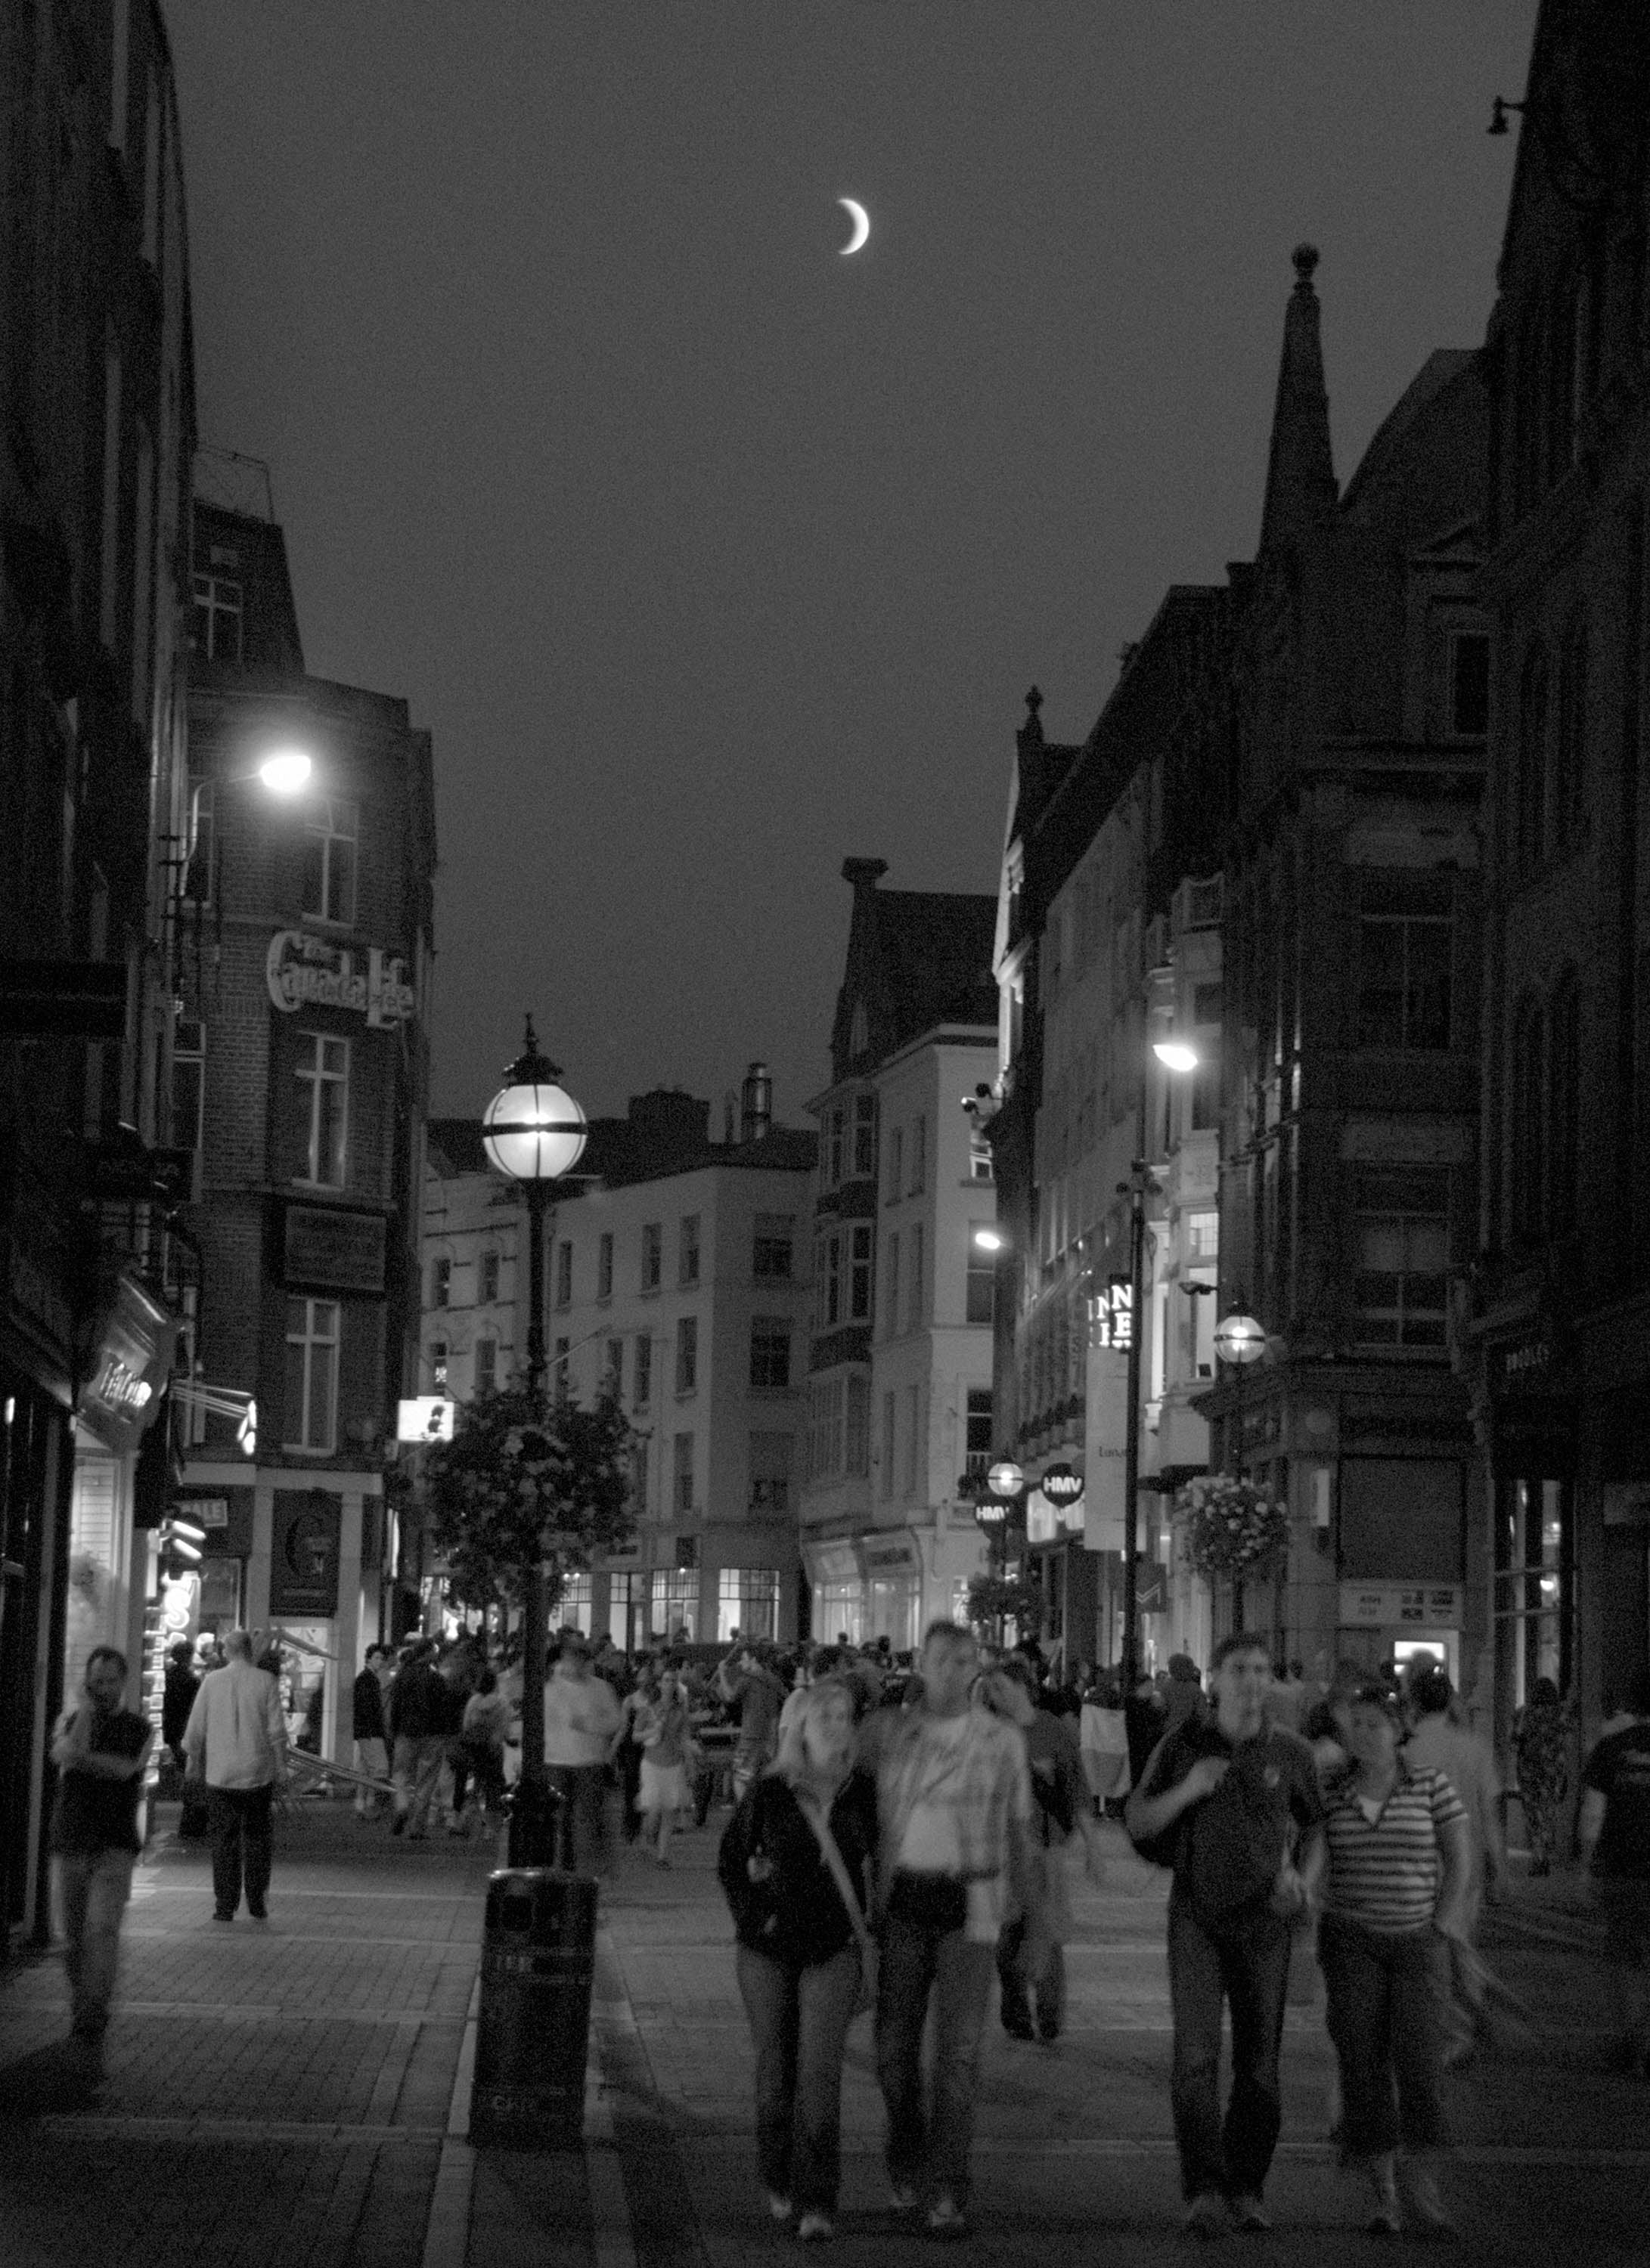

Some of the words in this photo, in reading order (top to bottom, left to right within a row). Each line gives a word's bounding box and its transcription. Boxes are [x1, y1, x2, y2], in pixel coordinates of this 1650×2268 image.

[268, 931, 366, 1012] Canada
[367, 947, 414, 1030] Life
[1043, 1476, 1082, 1492] HMV
